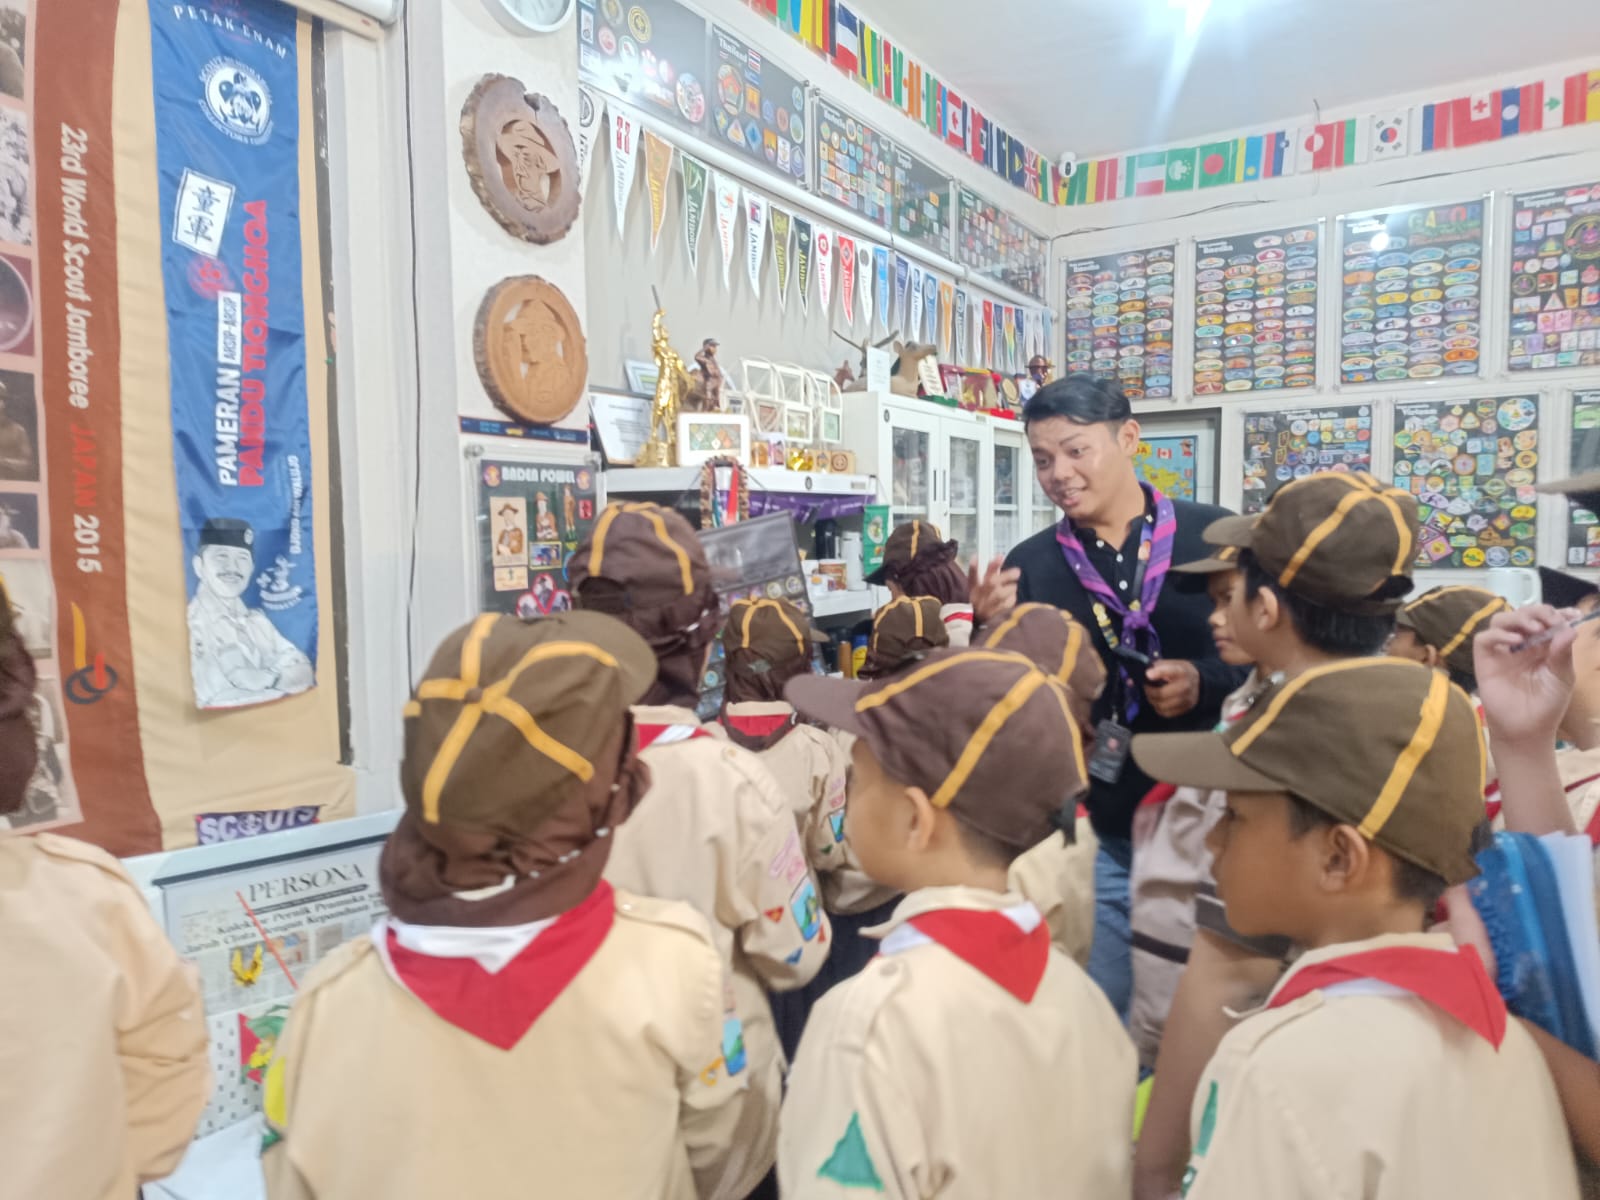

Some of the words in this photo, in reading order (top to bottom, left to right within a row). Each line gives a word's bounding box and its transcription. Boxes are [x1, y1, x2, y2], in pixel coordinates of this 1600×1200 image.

[173, 5, 234, 32] PETAK
[242, 24, 286, 59] ENAM
[60, 121, 89, 175] 23rd
[60, 175, 91, 238] World
[63, 240, 92, 303] Scout
[242, 200, 269, 374] TIONGHOA
[65, 303, 94, 410] Jamboree
[222, 296, 241, 361] ARSIP-ARSIP
[216, 367, 241, 487] PAMERAN
[239, 378, 268, 486] PANDU
[70, 422, 97, 508] JAPAN
[501, 465, 539, 482] BADEN
[73, 513, 103, 574] 2015
[249, 863, 366, 902] PERSONA
